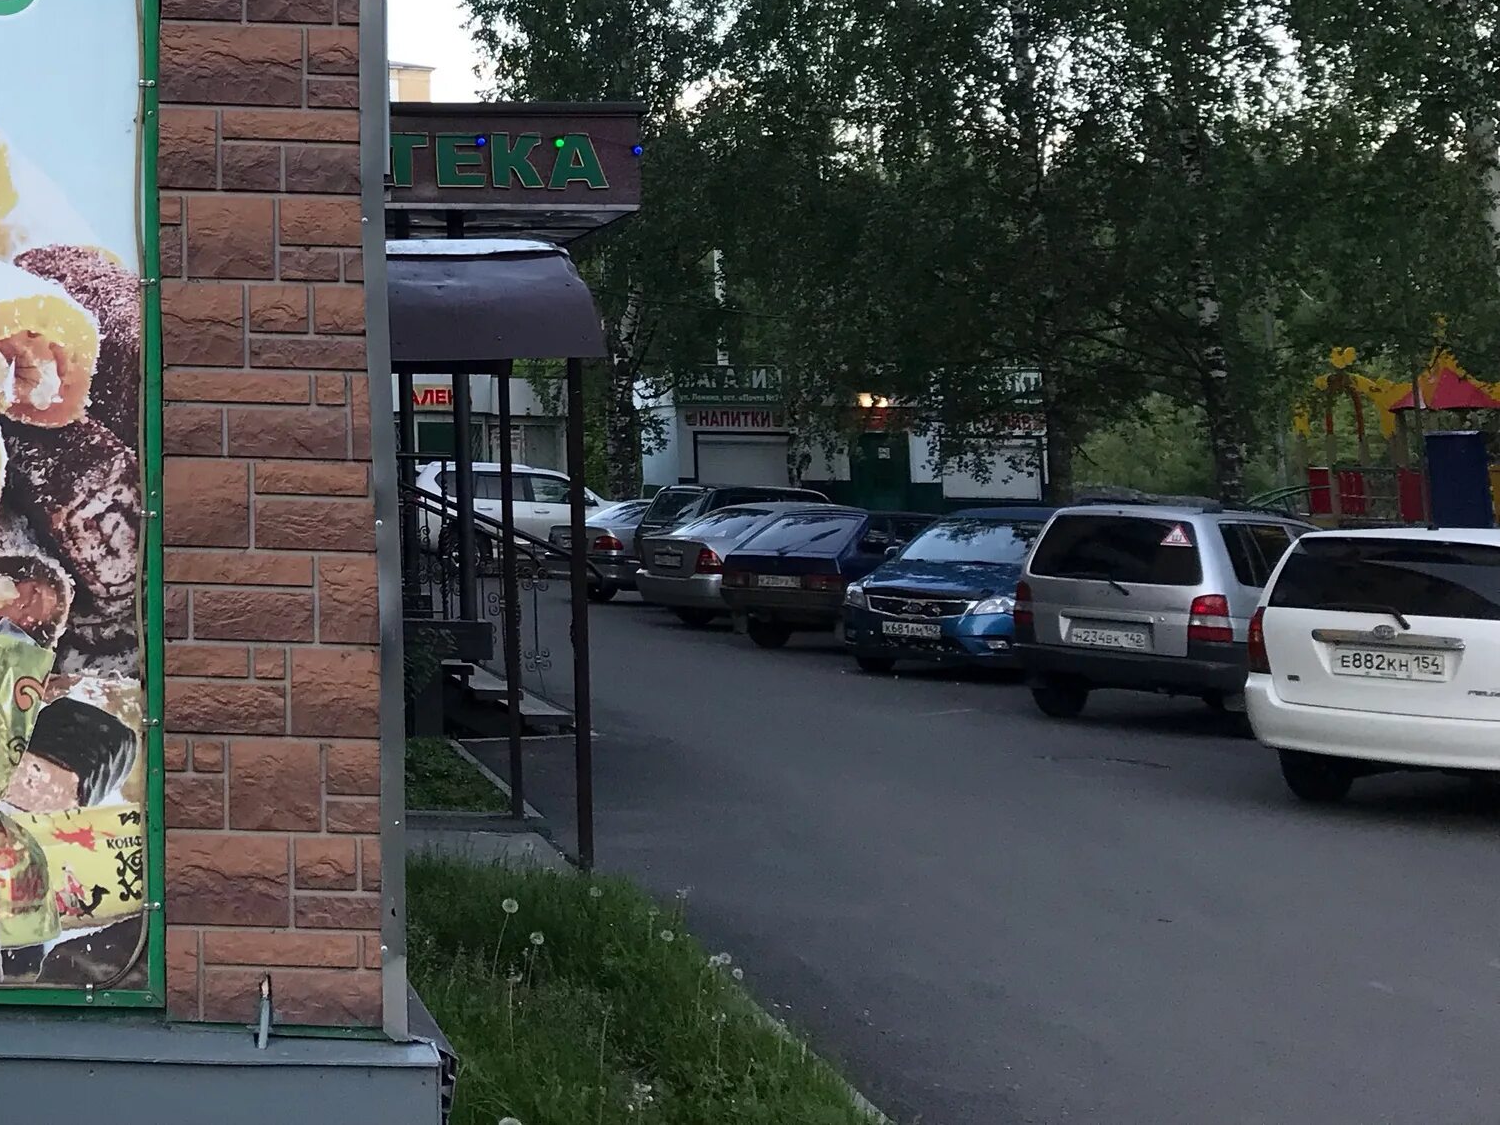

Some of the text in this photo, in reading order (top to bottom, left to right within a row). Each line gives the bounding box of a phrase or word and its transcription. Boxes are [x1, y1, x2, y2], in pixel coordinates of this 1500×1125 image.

[699, 411, 771, 428] НАПИТКИ
[1341, 653, 1441, 672] Е882КН 154
